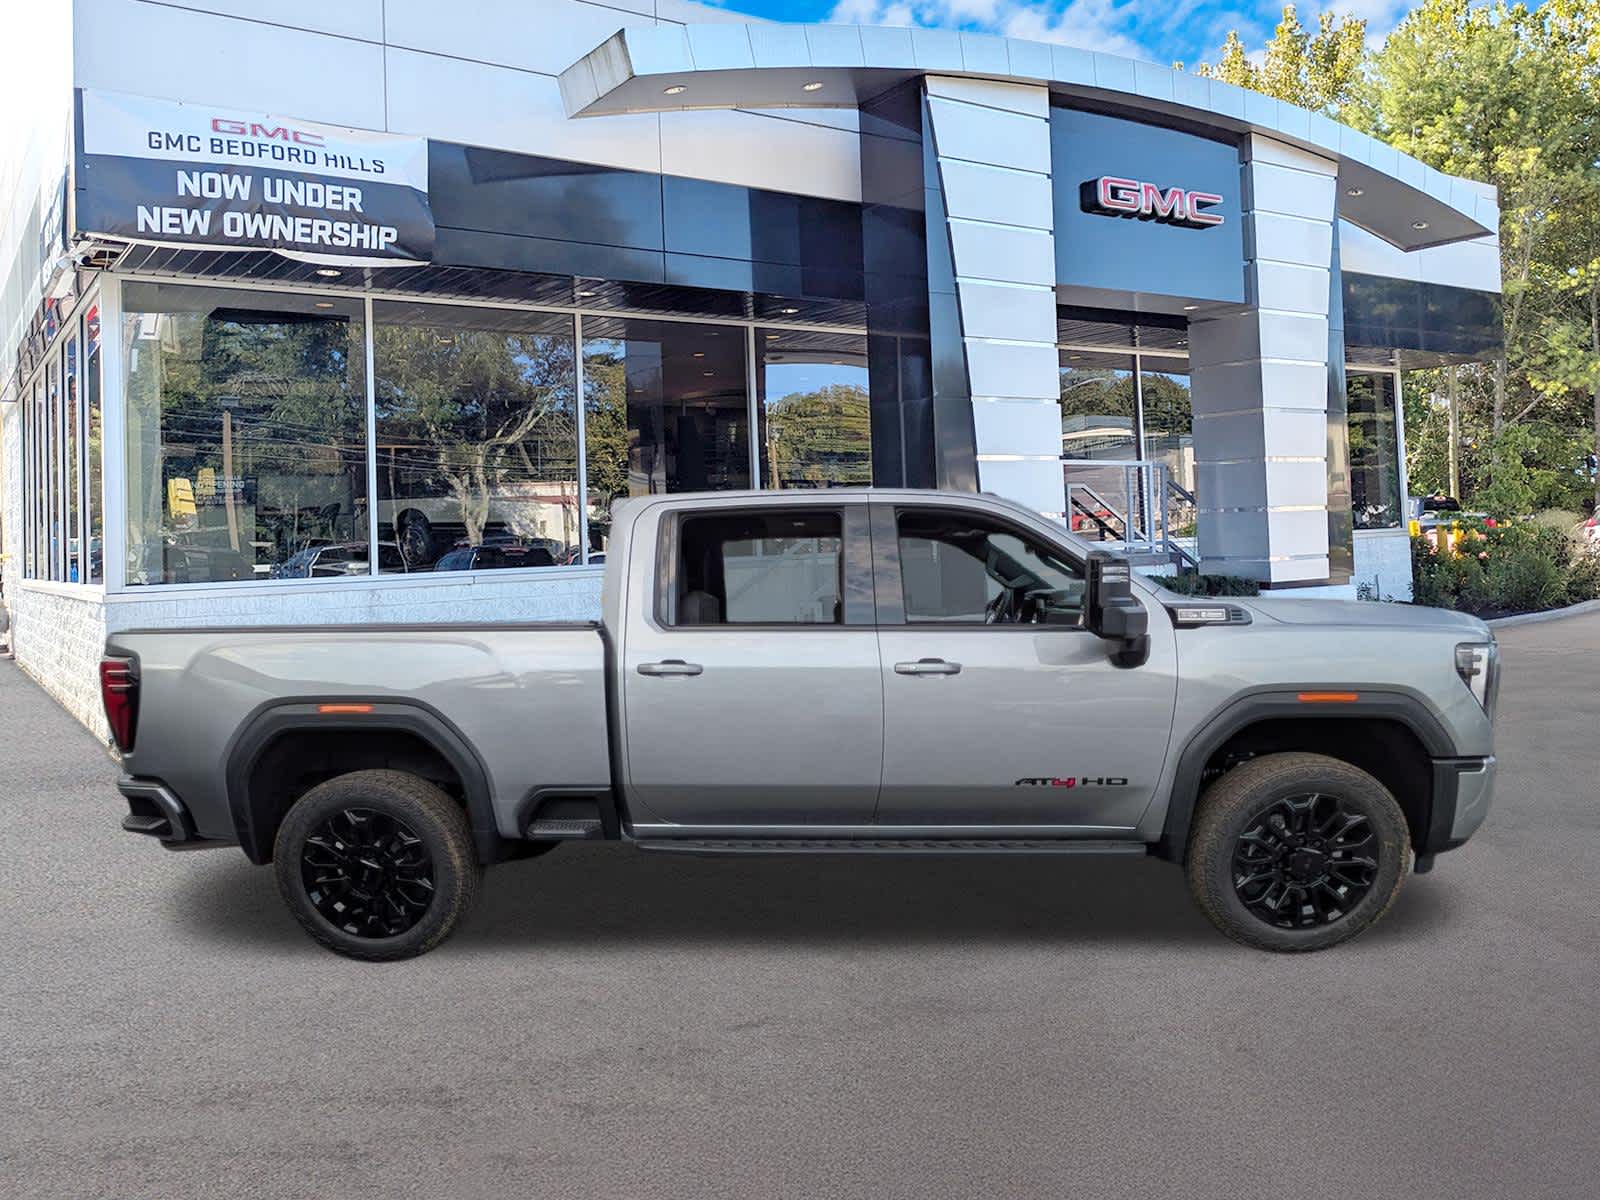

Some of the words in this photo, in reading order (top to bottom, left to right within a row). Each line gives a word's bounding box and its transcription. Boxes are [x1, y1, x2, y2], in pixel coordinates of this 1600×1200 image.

[148, 131, 201, 152] GMC
[210, 138, 317, 165] BEDFORD
[325, 154, 385, 174] HILLS
[211, 118, 326, 148] GMC
[177, 170, 252, 201] NOW
[263, 176, 364, 213] UNDER
[1098, 175, 1225, 225] GMC
[136, 206, 211, 236] NEW
[223, 211, 399, 250] OWNERSHIP
[1015, 778, 1076, 788] AT4
[1082, 778, 1128, 786] HD
